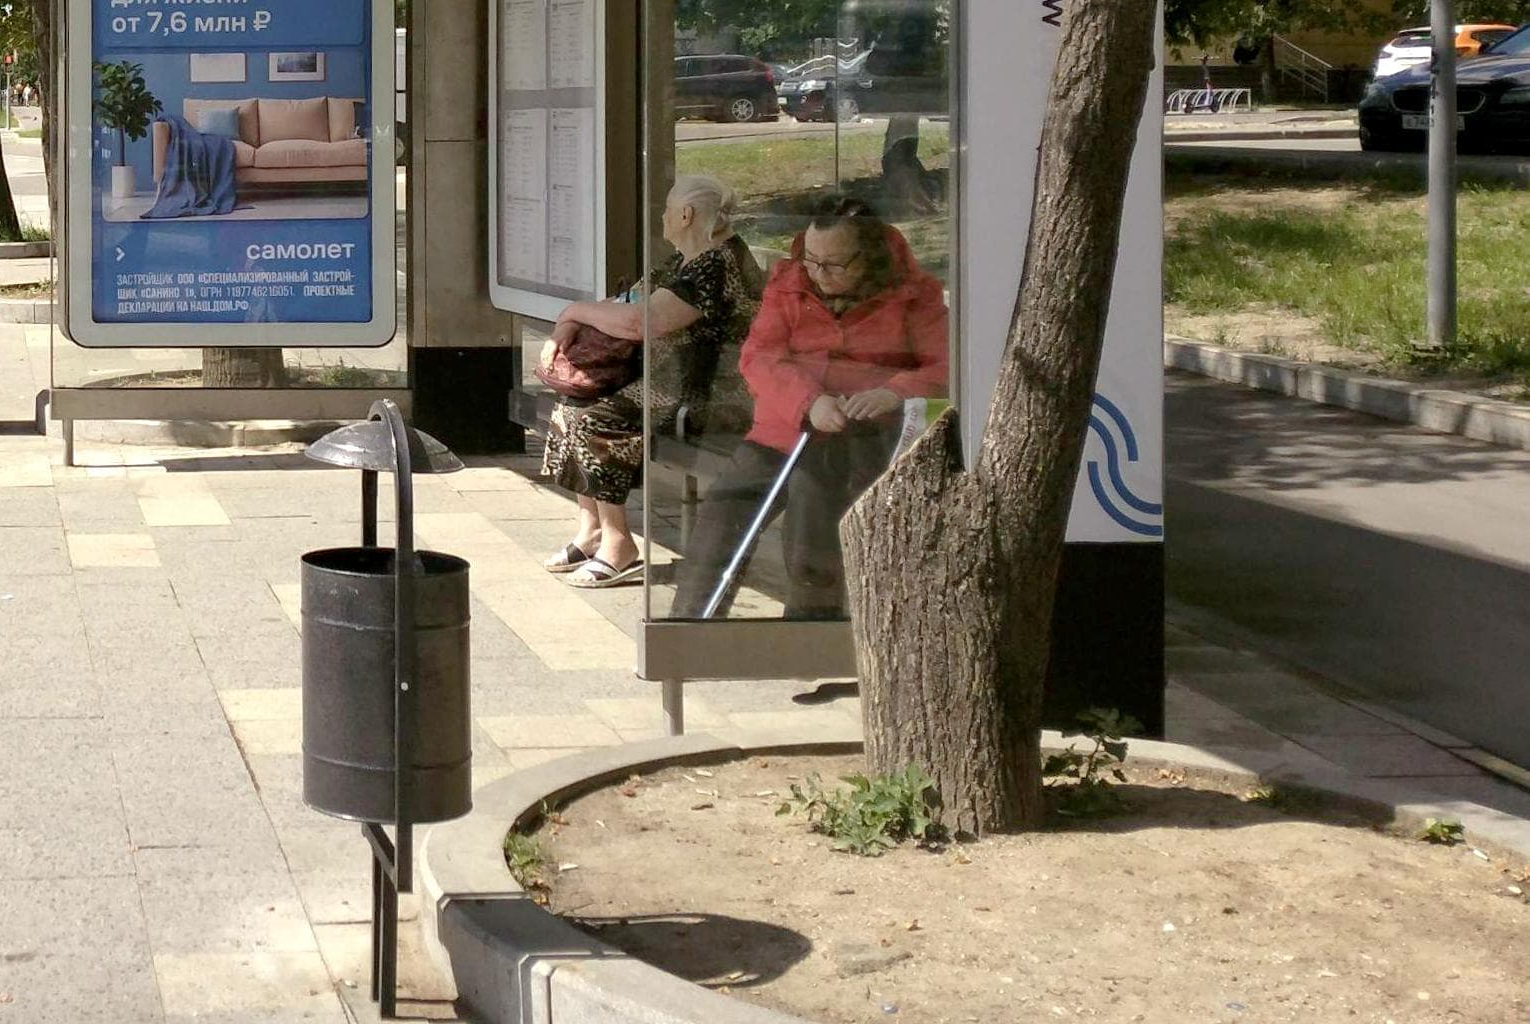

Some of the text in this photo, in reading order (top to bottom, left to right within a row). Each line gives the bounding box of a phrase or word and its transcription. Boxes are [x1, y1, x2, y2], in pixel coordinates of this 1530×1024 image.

[111, 16, 141, 33] от
[146, 10, 188, 37] 7,6
[194, 15, 246, 33] млн
[246, 243, 356, 260] самолет
[200, 286, 222, 298] ОГРН
